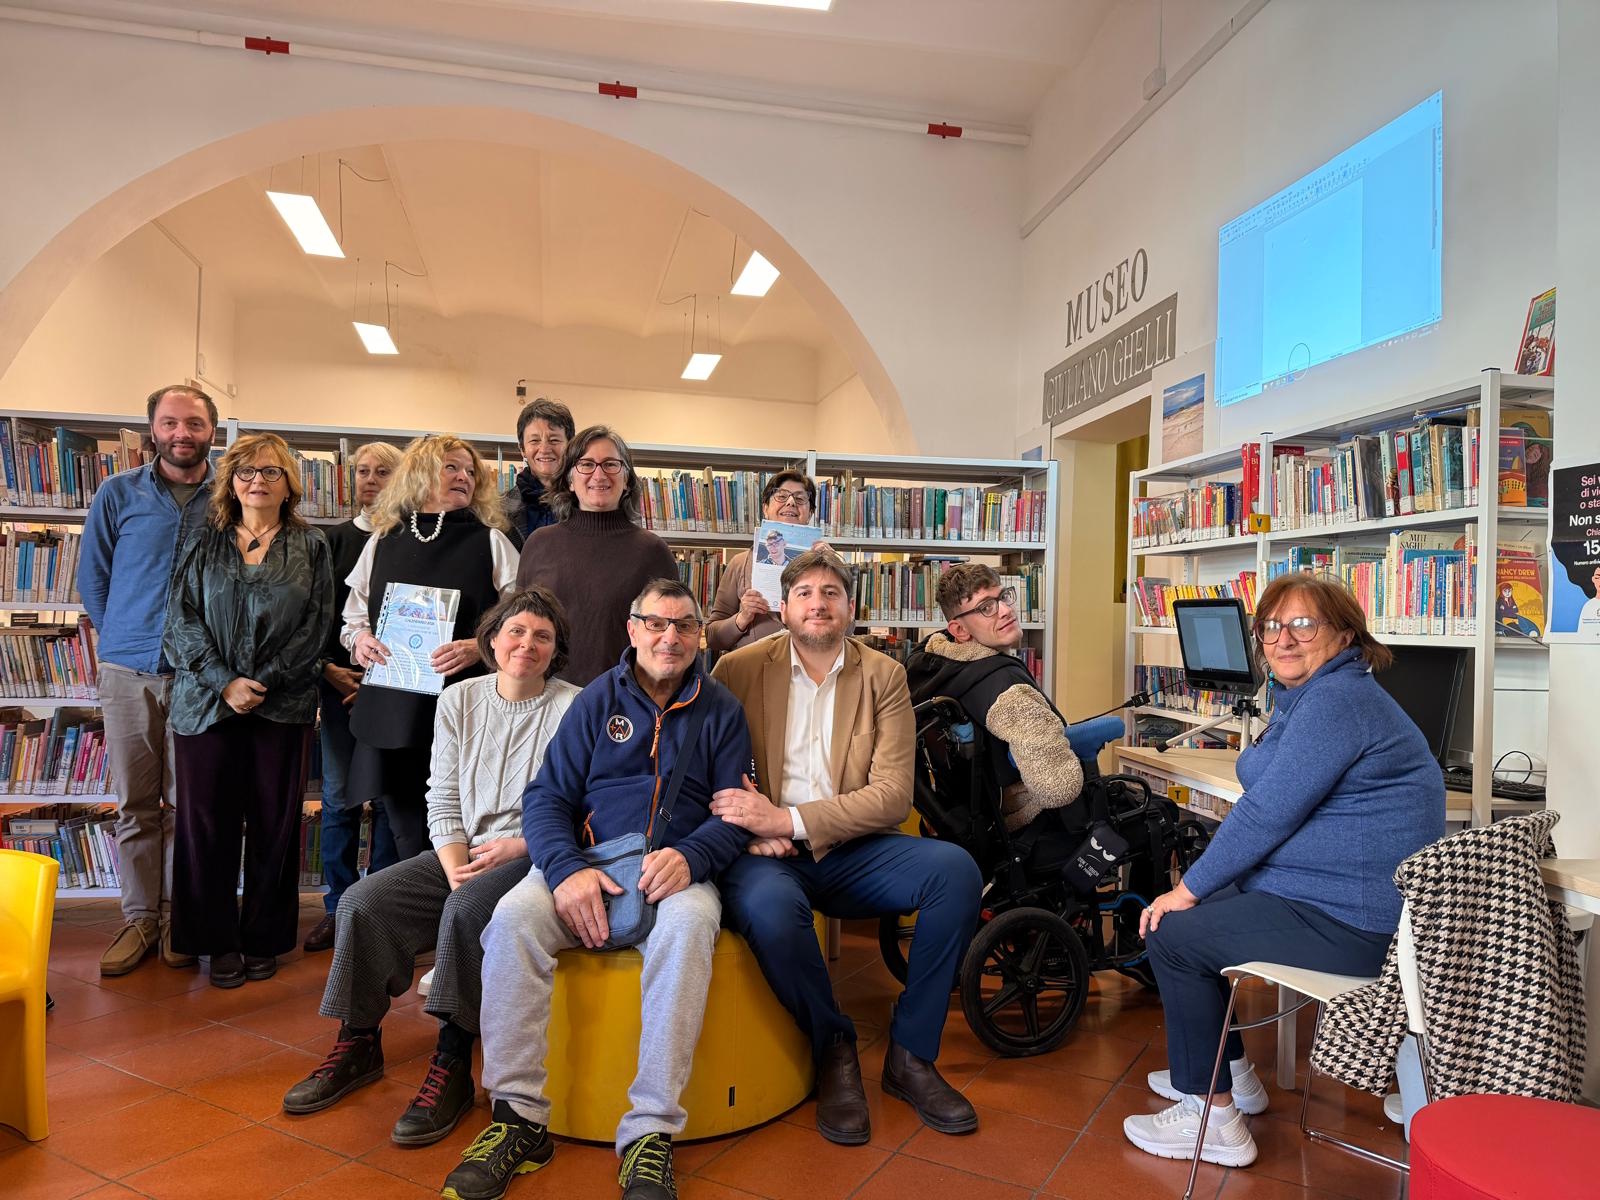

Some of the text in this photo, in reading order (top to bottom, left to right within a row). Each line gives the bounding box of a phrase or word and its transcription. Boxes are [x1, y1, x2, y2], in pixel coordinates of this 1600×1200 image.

[1065, 248, 1148, 348] MUSEO
[1046, 309, 1173, 418] GIULIANO GHELLI
[1581, 474, 1596, 487] Sei
[1580, 487, 1590, 498] di
[1580, 501, 1586, 509] o
[1256, 518, 1263, 528] V
[1569, 514, 1592, 527] Non
[1174, 790, 1182, 800] T
